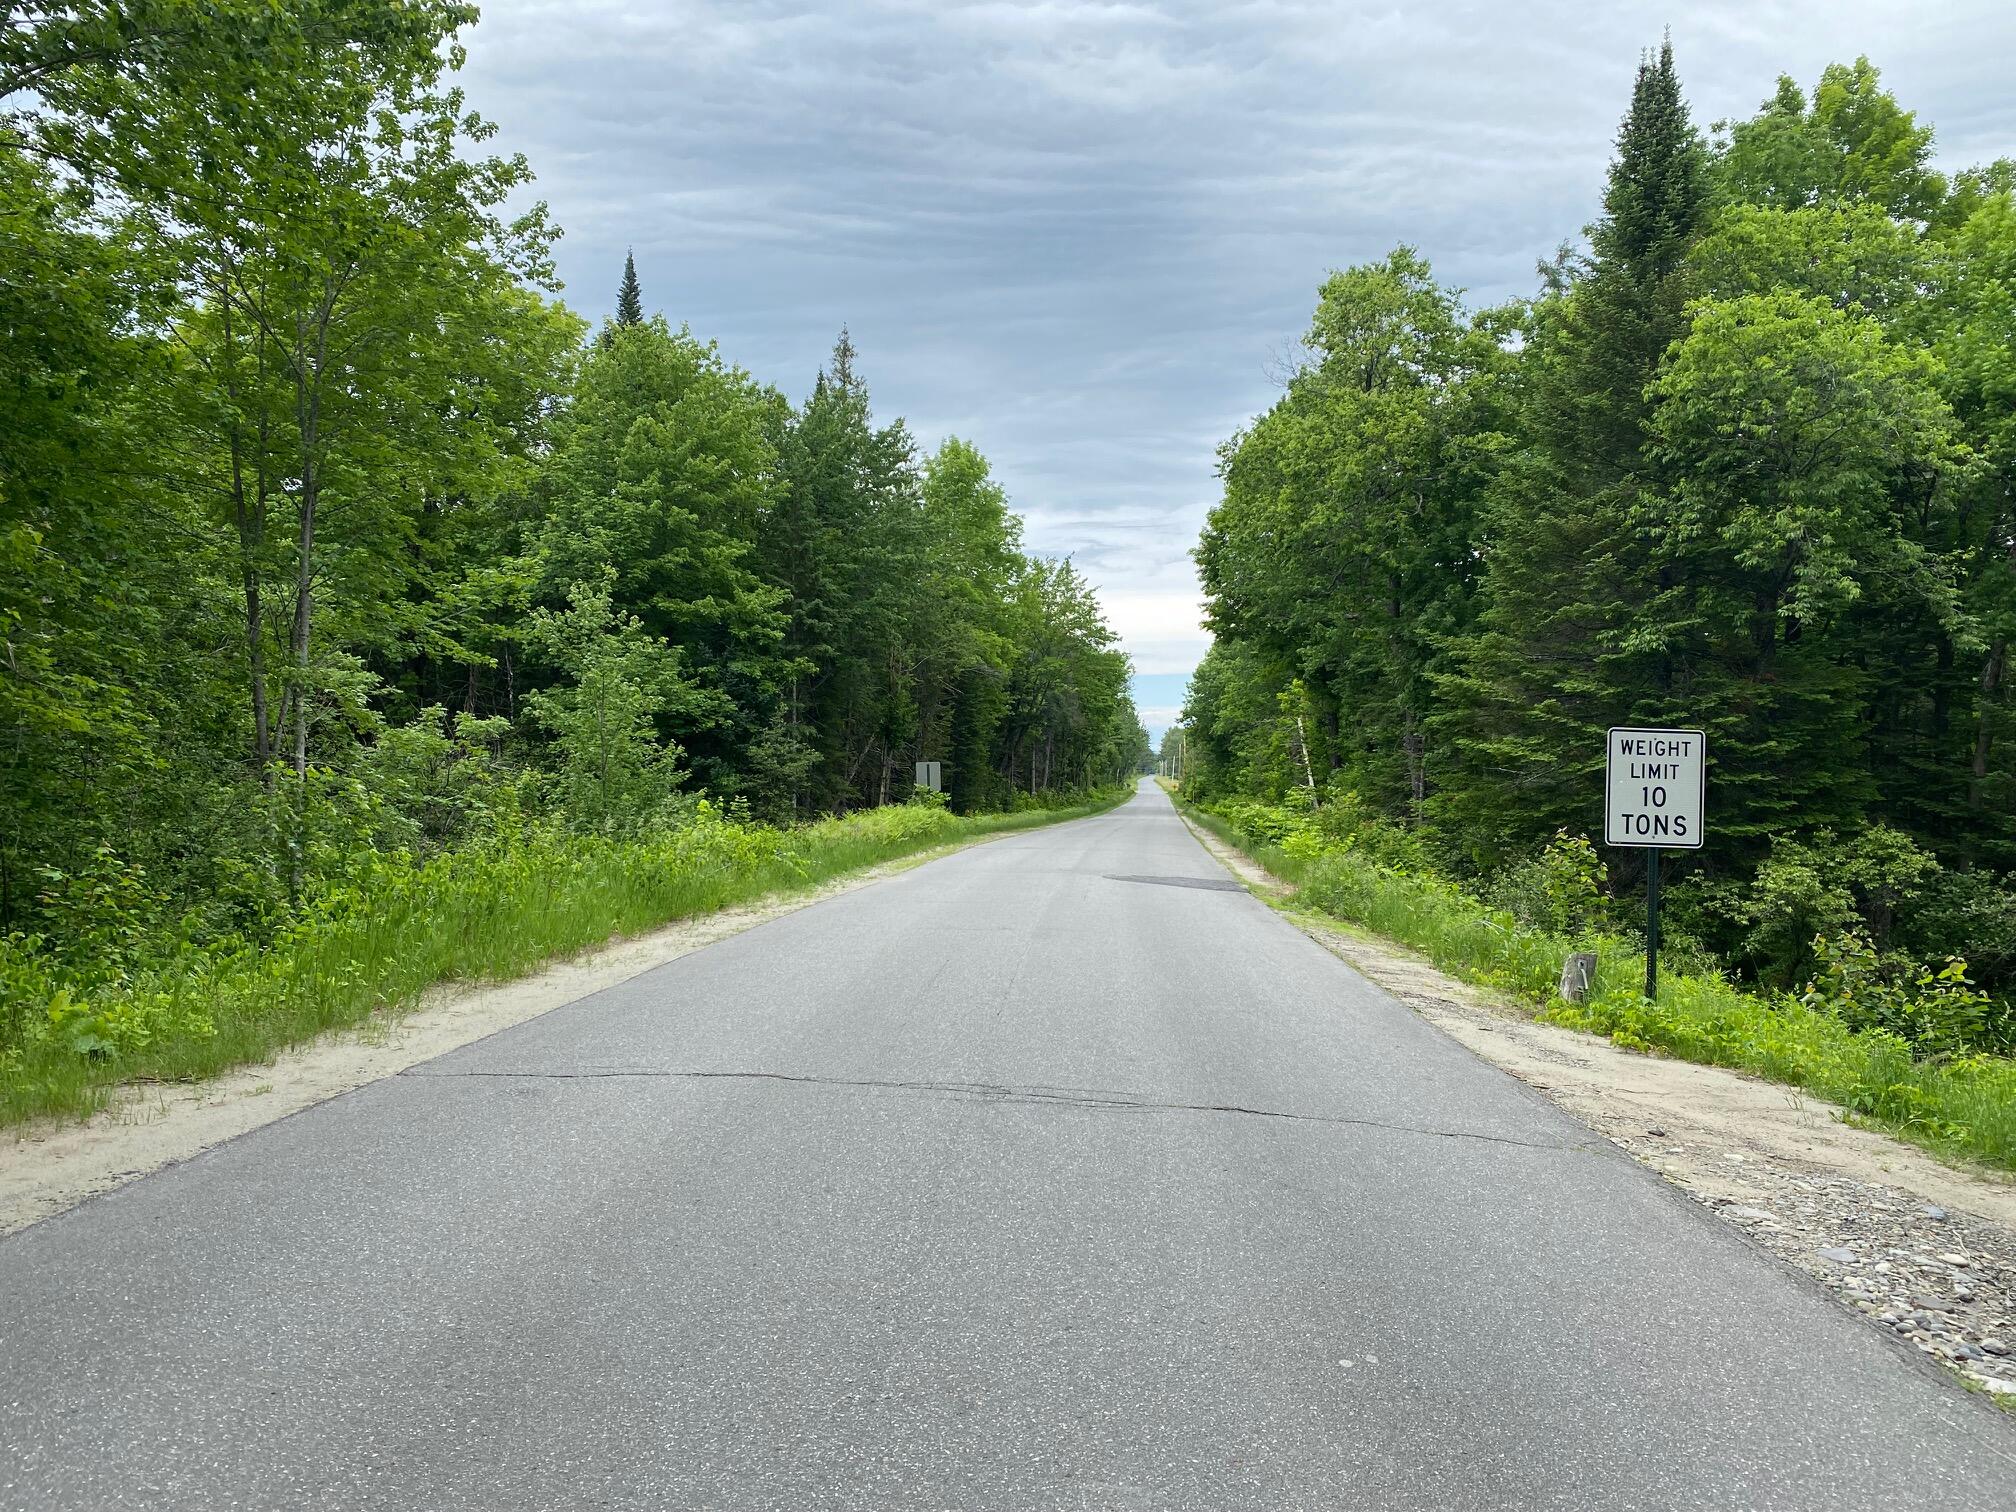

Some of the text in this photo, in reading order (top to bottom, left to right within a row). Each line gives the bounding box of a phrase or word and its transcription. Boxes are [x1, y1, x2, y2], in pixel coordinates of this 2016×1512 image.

[1620, 739, 1691, 757] WEIGHT
[1630, 762, 1679, 780] LIMIT
[1642, 786, 1667, 807] 10
[1621, 813, 1687, 836] TONS
